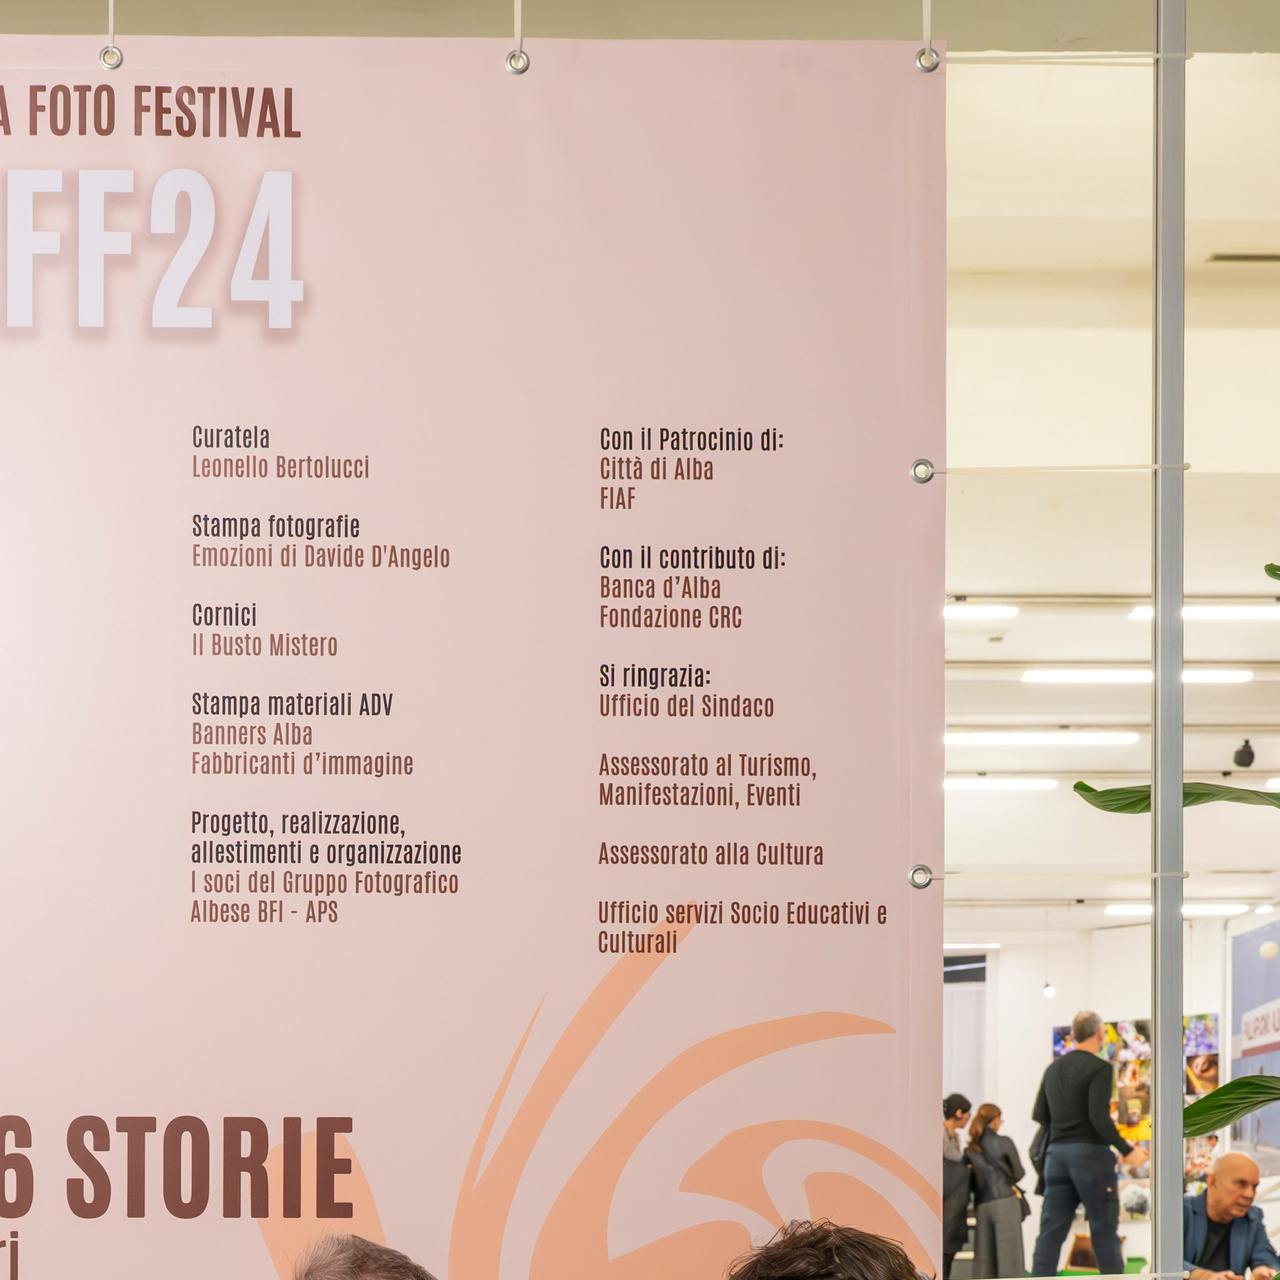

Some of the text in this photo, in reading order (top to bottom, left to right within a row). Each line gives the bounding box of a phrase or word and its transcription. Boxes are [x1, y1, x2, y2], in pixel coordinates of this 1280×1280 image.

[28, 84, 116, 136] FOTO
[133, 85, 302, 139] FESTIVAL
[192, 424, 270, 449] Curatela
[600, 426, 784, 452] Con il Patrocinio di:
[192, 454, 370, 479] Leonello Bertolucci
[600, 455, 714, 481] Città di Alba
[600, 486, 636, 510] FIAF
[192, 513, 360, 541] Stampa fotografie
[192, 543, 273, 568] Emozioni
[280, 543, 297, 568] di
[304, 543, 365, 568] Davide
[599, 544, 786, 570] Con il contributo di:
[600, 575, 656, 599] Banca
[192, 602, 257, 627] Cornici
[600, 604, 742, 629] Fondazione CRC
[192, 632, 338, 657] Il Busto Mistero
[599, 663, 711, 691] Si ringrazia:
[191, 691, 394, 719] Stampa materiali ADV
[599, 693, 775, 718] Ufficio del Sindaco
[192, 721, 313, 746] Banners Alba
[191, 750, 296, 775] Fabbricanti
[598, 752, 817, 782] Assessorato al Turismo,
[599, 781, 801, 811] Manifestazioni, Eventi
[191, 810, 406, 839] Progetto, realizzazione,
[190, 839, 462, 867] allestimenti e organizzazione
[597, 841, 824, 866] Assessorato alla Cultura
[191, 870, 459, 897] I soci del Gruppo Fotografico
[190, 899, 251, 923] Albese
[257, 899, 283, 923] BFI
[305, 899, 339, 924] APS
[598, 899, 887, 925] Ufficio servizi Socio Educativi e
[598, 929, 678, 954] Culturali
[67, 1116, 353, 1219] STORIE
